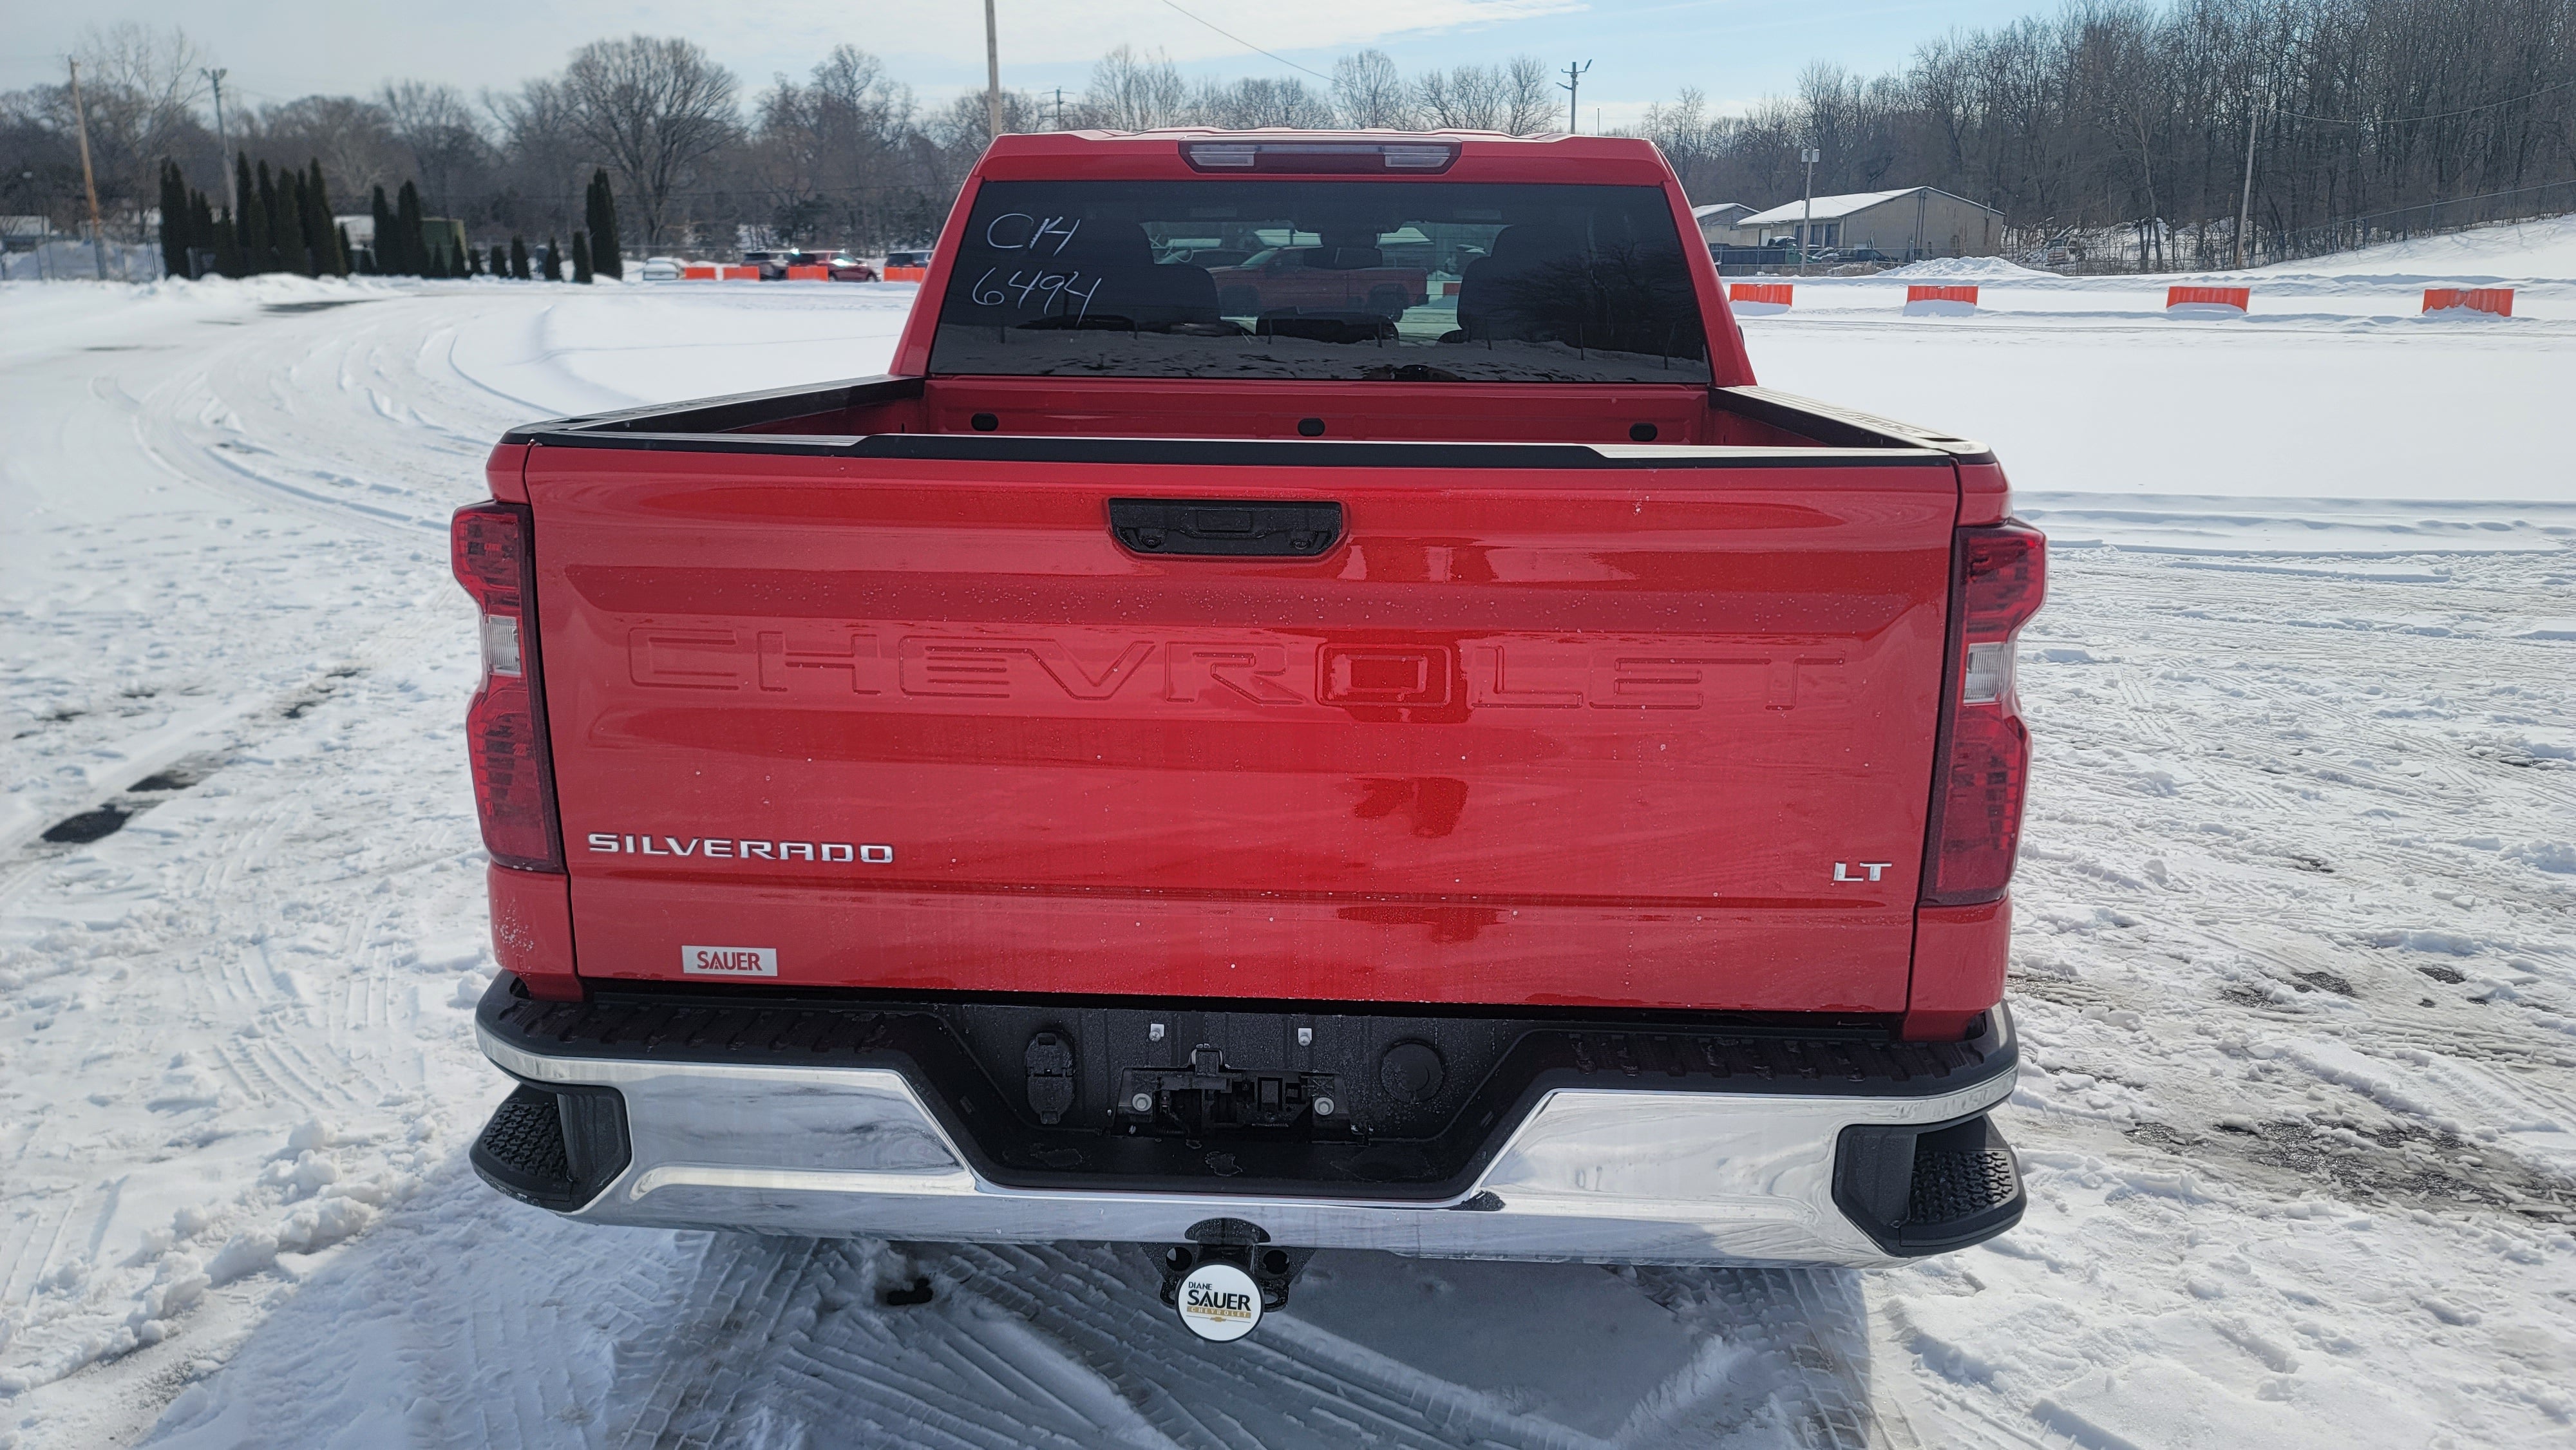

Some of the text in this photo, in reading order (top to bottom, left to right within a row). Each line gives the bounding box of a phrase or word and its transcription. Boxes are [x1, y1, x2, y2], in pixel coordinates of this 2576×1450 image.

[972, 267, 1102, 327] 6494
[629, 627, 1847, 711] CHEVROLET
[587, 833, 895, 863] SILVERADO
[1833, 862, 1893, 882] LT
[697, 950, 762, 971] SAUER
[1188, 1281, 1213, 1290] DIANE
[1187, 1289, 1251, 1312] SAUER
[1191, 1306, 1247, 1317] CHEVROLET
